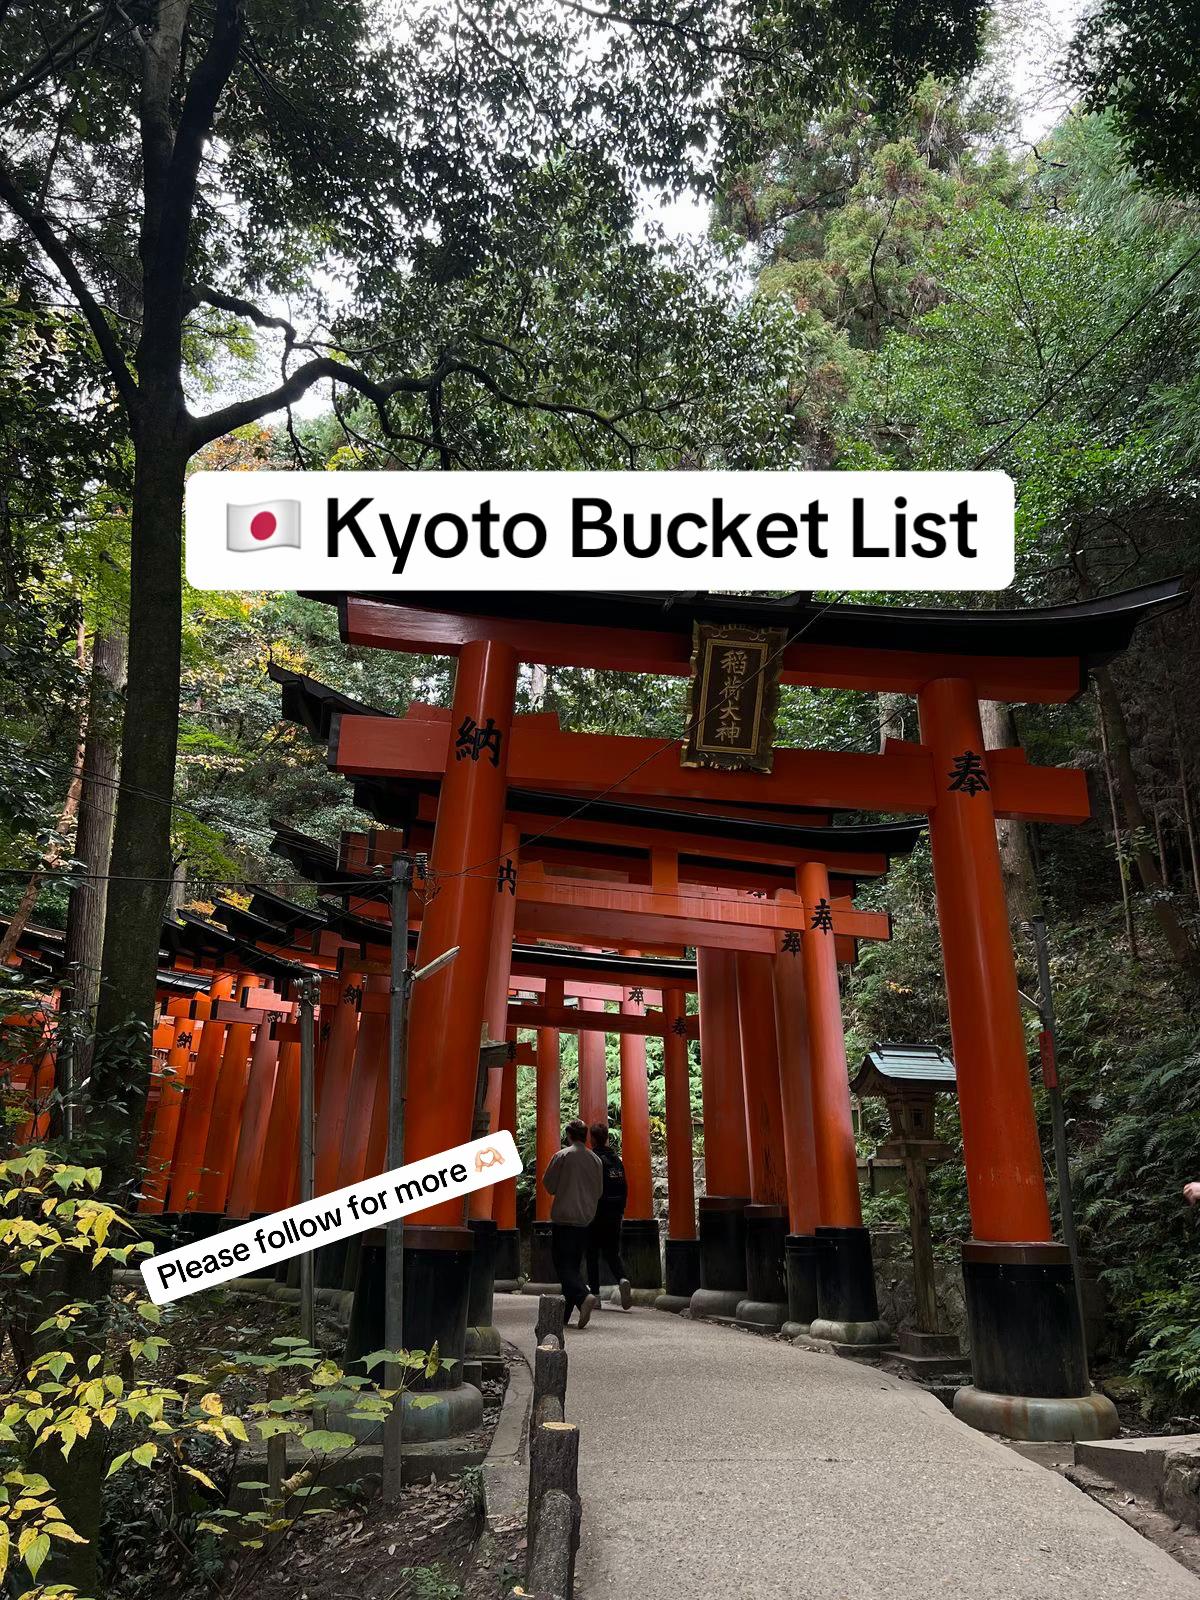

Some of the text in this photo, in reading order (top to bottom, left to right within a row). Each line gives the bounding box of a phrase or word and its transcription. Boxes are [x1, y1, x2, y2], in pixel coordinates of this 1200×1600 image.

[455, 716, 501, 768] 納
[946, 750, 990, 797] 奉
[810, 898, 834, 936] 奉
